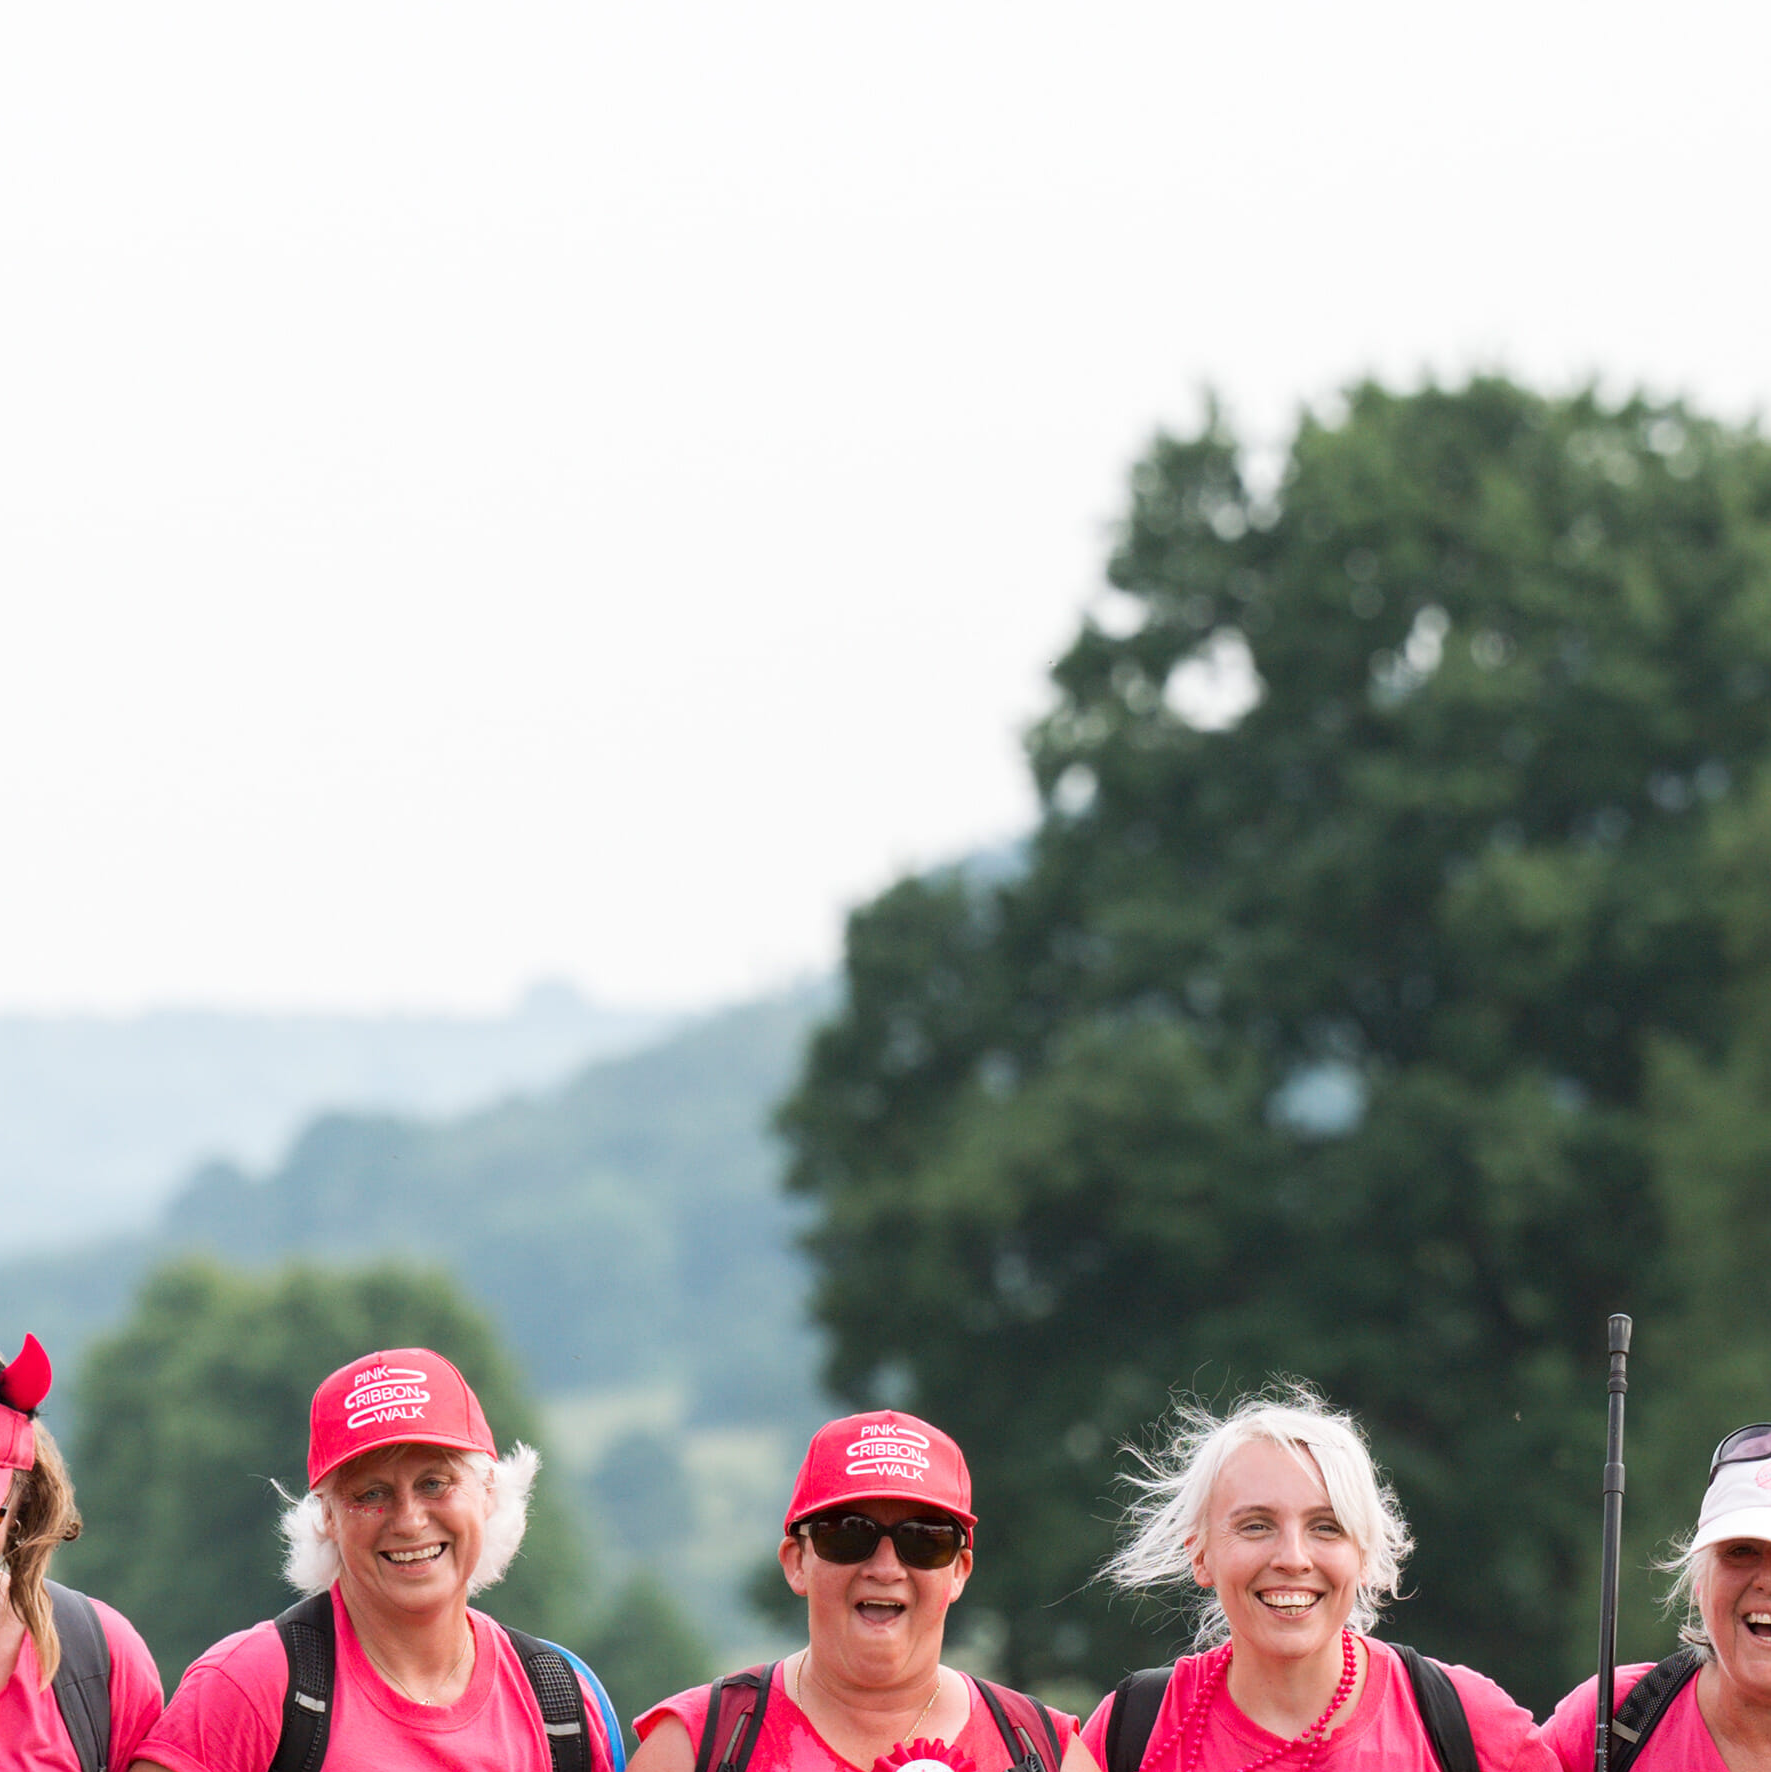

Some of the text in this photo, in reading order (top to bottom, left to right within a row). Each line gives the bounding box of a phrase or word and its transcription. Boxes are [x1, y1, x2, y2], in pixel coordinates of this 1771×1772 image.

[354, 1365, 390, 1387] PINK
[356, 1385, 421, 1408] RIBBON
[374, 1406, 425, 1423] WALK
[861, 1424, 897, 1438] PINK
[860, 1443, 922, 1461] RIBBON
[876, 1463, 925, 1482] WALK
